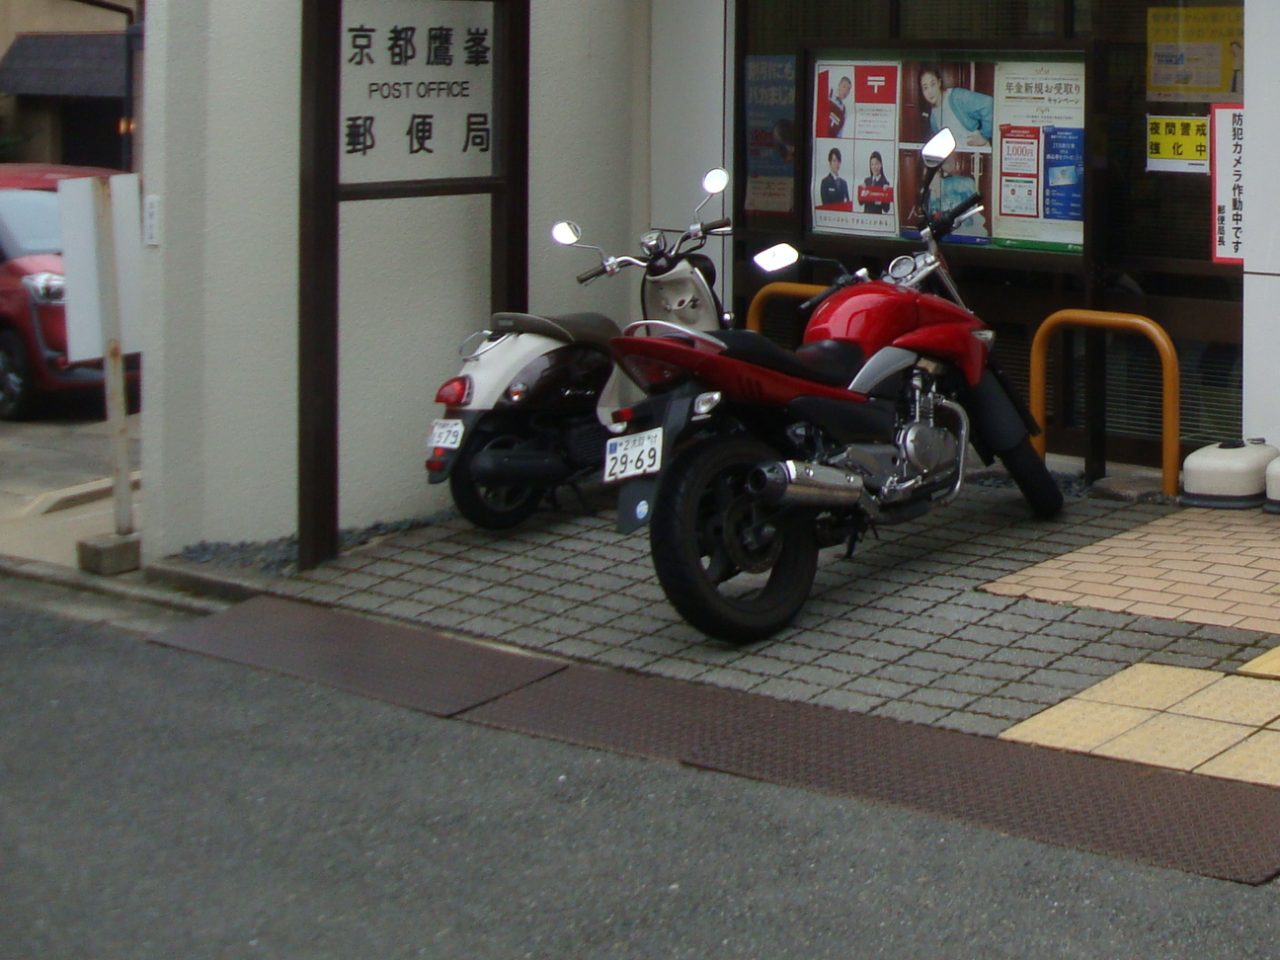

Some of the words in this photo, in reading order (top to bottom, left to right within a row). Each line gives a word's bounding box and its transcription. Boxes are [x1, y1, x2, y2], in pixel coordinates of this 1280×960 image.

[347, 24, 491, 66] 京都鷹峯
[368, 82, 412, 100] POST
[416, 81, 470, 98] OFFICE
[345, 113, 491, 156] 郵便局
[1149, 121, 1208, 137] 夜間警戒
[1149, 141, 1207, 157] 強化中
[1231, 113, 1244, 253] 防犯カメラ作動中です
[1217, 204, 1226, 247] 郵便局長
